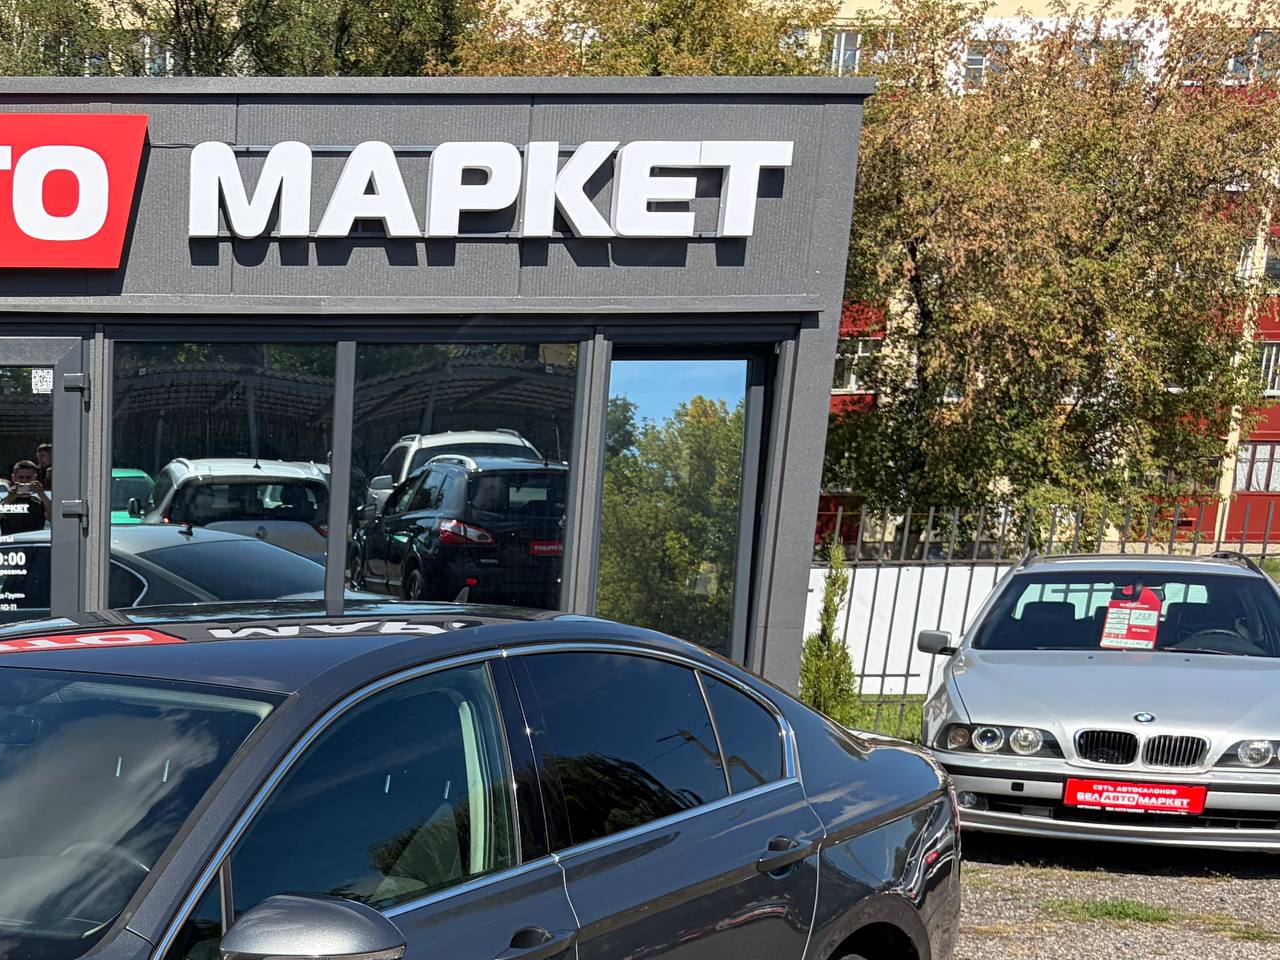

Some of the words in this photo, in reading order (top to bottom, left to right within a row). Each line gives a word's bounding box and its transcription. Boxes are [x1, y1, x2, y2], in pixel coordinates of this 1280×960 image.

[188, 140, 794, 240] МАРКЕТ
[1115, 786, 1177, 795] АВТОСАЛОНОВ
[1076, 791, 1100, 801] БЕЛ
[1103, 793, 1138, 803] АВТО
[1138, 796, 1191, 808] МАРКЕТ
